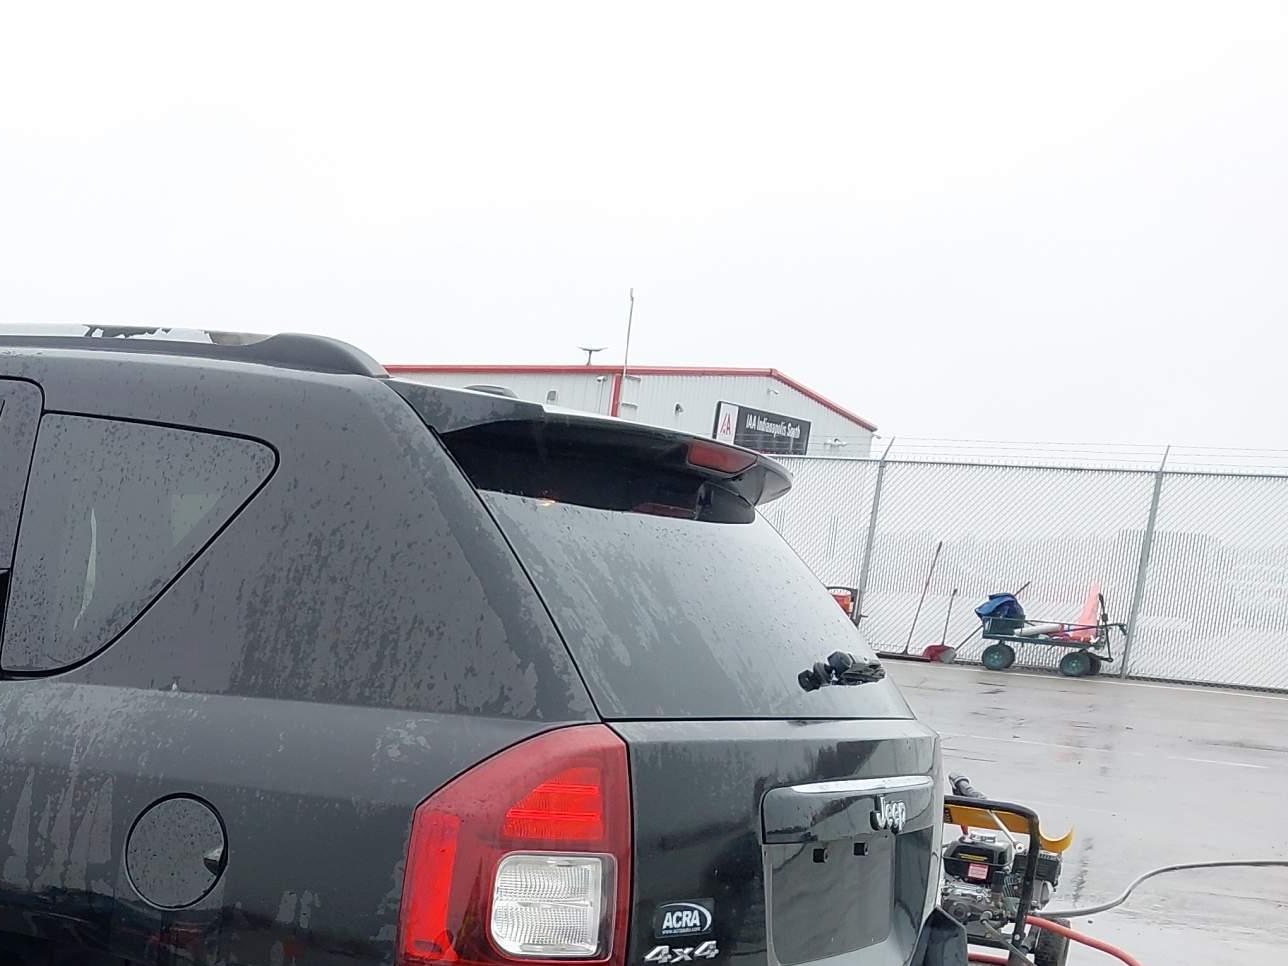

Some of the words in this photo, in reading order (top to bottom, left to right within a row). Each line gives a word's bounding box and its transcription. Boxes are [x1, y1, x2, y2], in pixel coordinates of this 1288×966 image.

[746, 414, 756, 430] IAA
[787, 423, 800, 438] South
[876, 796, 906, 831] Jeep
[662, 909, 701, 929] ACRA
[644, 940, 720, 964] 4x4
